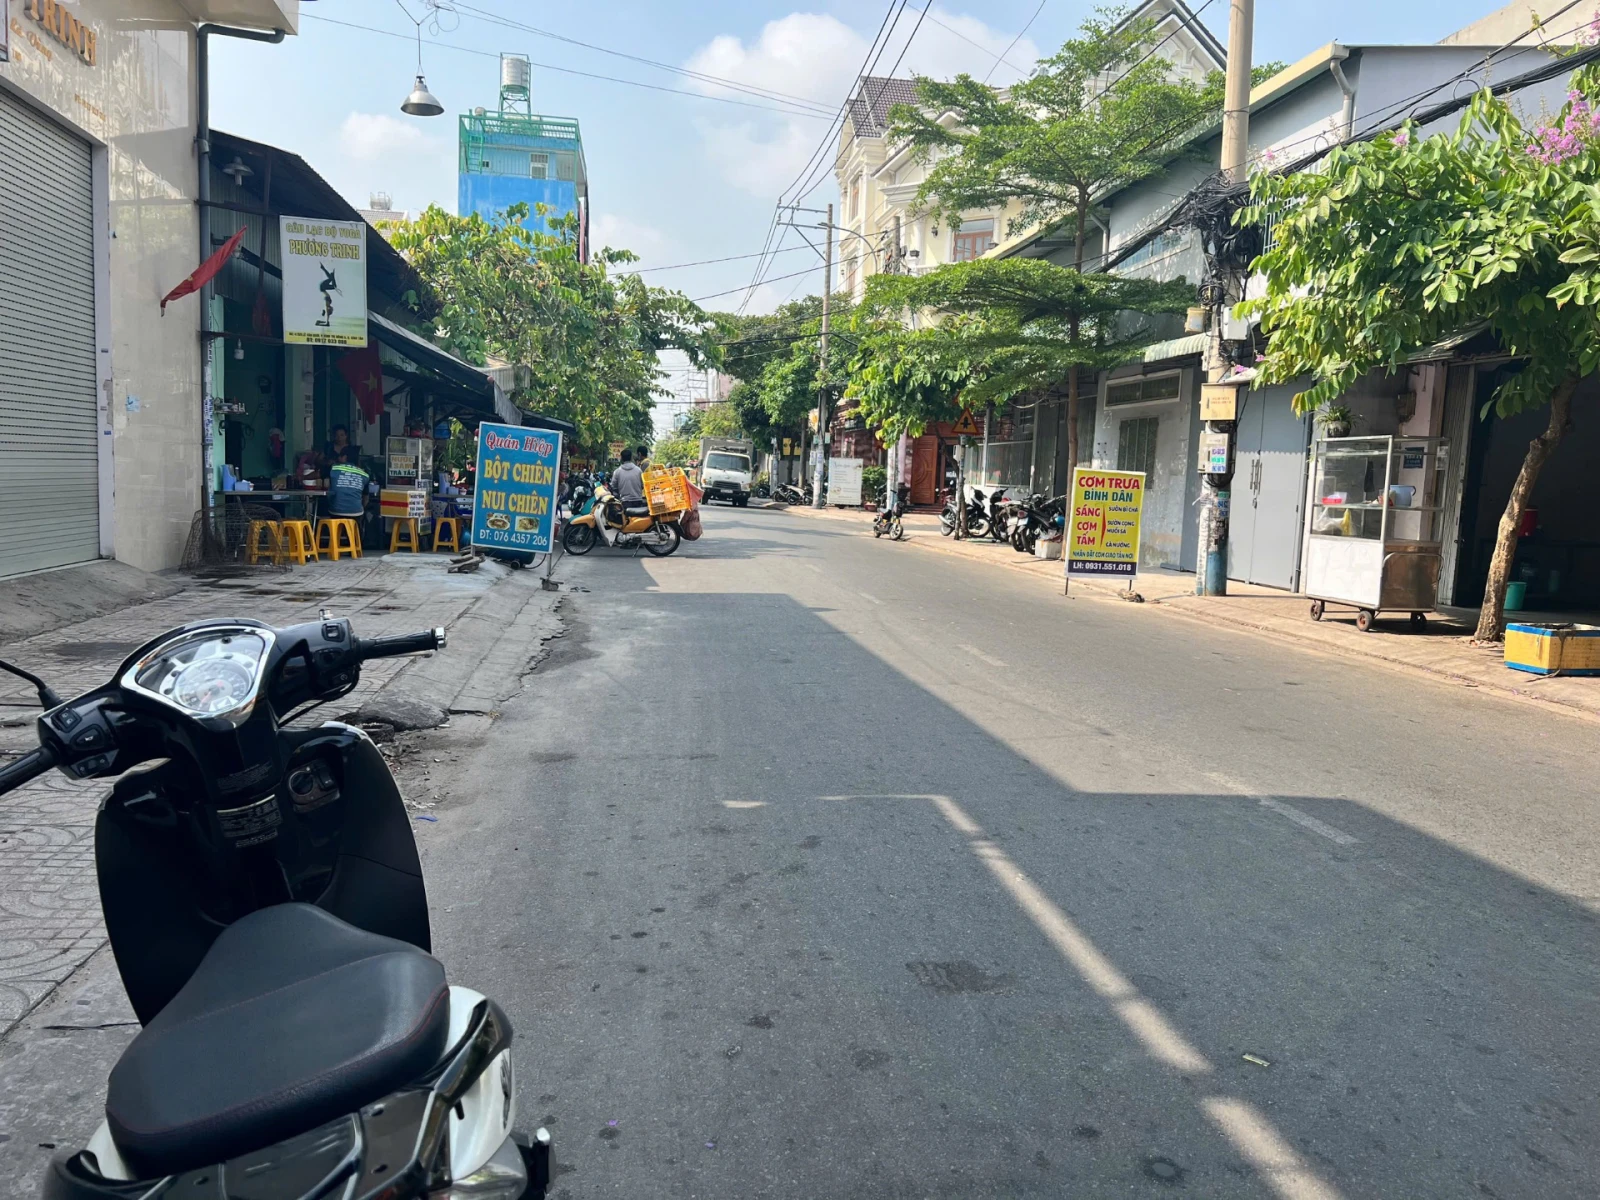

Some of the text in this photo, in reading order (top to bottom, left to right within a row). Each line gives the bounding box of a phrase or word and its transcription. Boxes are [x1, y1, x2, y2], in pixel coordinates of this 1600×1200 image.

[339, 228, 361, 239] YOGA
[330, 243, 360, 260] TRINH
[486, 432, 553, 457] Quán Hiệp
[484, 455, 553, 485] BỘT CHIÊN
[1079, 476, 1140, 489] CƠM TRƯA
[1084, 488, 1133, 502] BÌNH DÂN
[482, 490, 549, 515] NUI CHIÊN
[1076, 504, 1100, 517] SÁNG
[1077, 521, 1097, 531] CƠM
[480, 530, 548, 546] ĐT: 076 4357 206
[1077, 531, 1096, 545] TẤM
[1085, 562, 1132, 571] 0931.551.018
